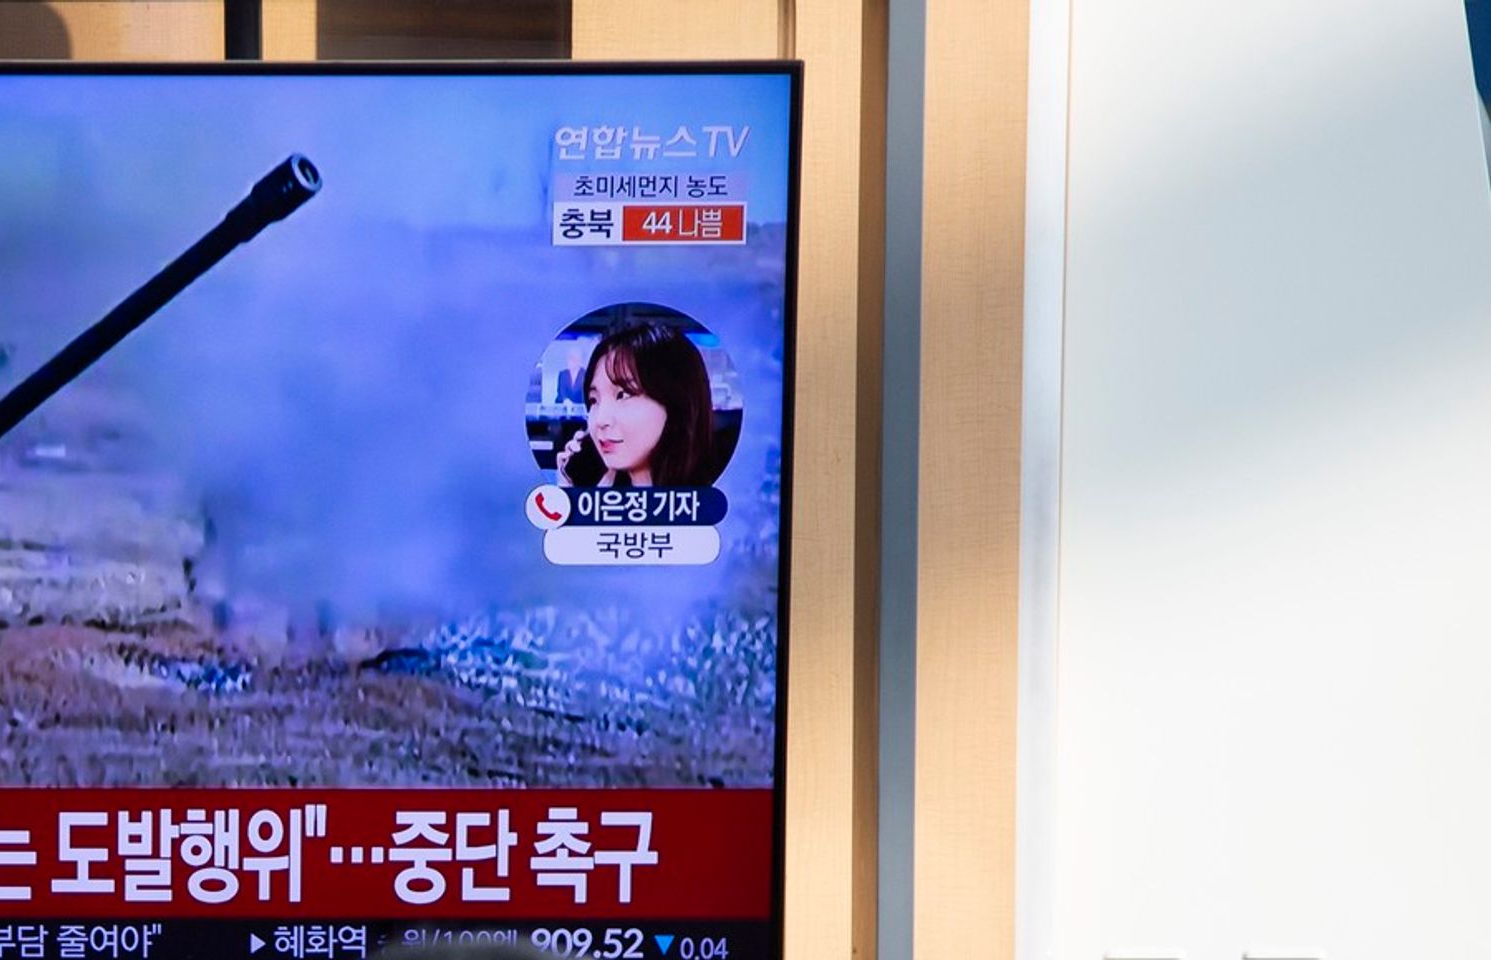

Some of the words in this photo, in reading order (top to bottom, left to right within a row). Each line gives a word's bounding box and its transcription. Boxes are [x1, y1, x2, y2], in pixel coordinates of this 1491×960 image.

[555, 124, 750, 161] 연합뉴스TV
[573, 175, 678, 199] 초미세먼지
[686, 175, 728, 199] 농도
[559, 208, 614, 239] 충북
[641, 211, 672, 235] 44
[678, 208, 723, 238] 나쁨
[577, 490, 648, 522] 이은정
[653, 490, 700, 522] 기자
[596, 532, 674, 559] 국방부
[530, 806, 659, 904] 촉구
[56, 922, 162, 960] 줄여야"
[273, 924, 367, 960] 혜화역
[530, 928, 645, 959] 909.52
[680, 937, 729, 960] 0.04
